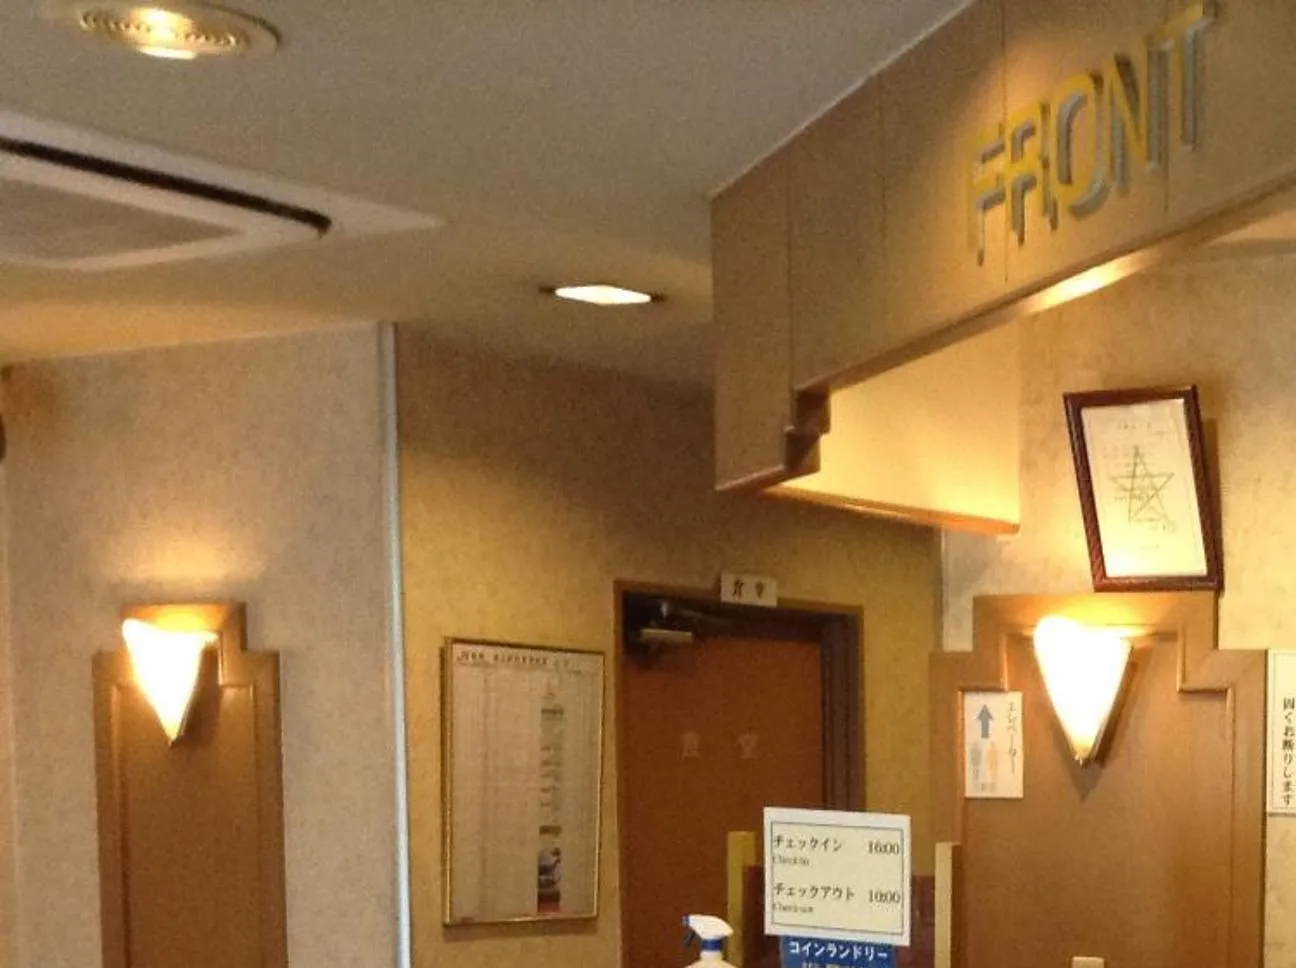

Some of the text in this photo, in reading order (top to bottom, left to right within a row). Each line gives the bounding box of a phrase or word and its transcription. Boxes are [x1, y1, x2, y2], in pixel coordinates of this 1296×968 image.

[966, 2, 1212, 263] FRONT
[775, 835, 842, 852] チェックイン
[774, 882, 855, 901] チェックアウト
[789, 940, 888, 961] コインランドリー
